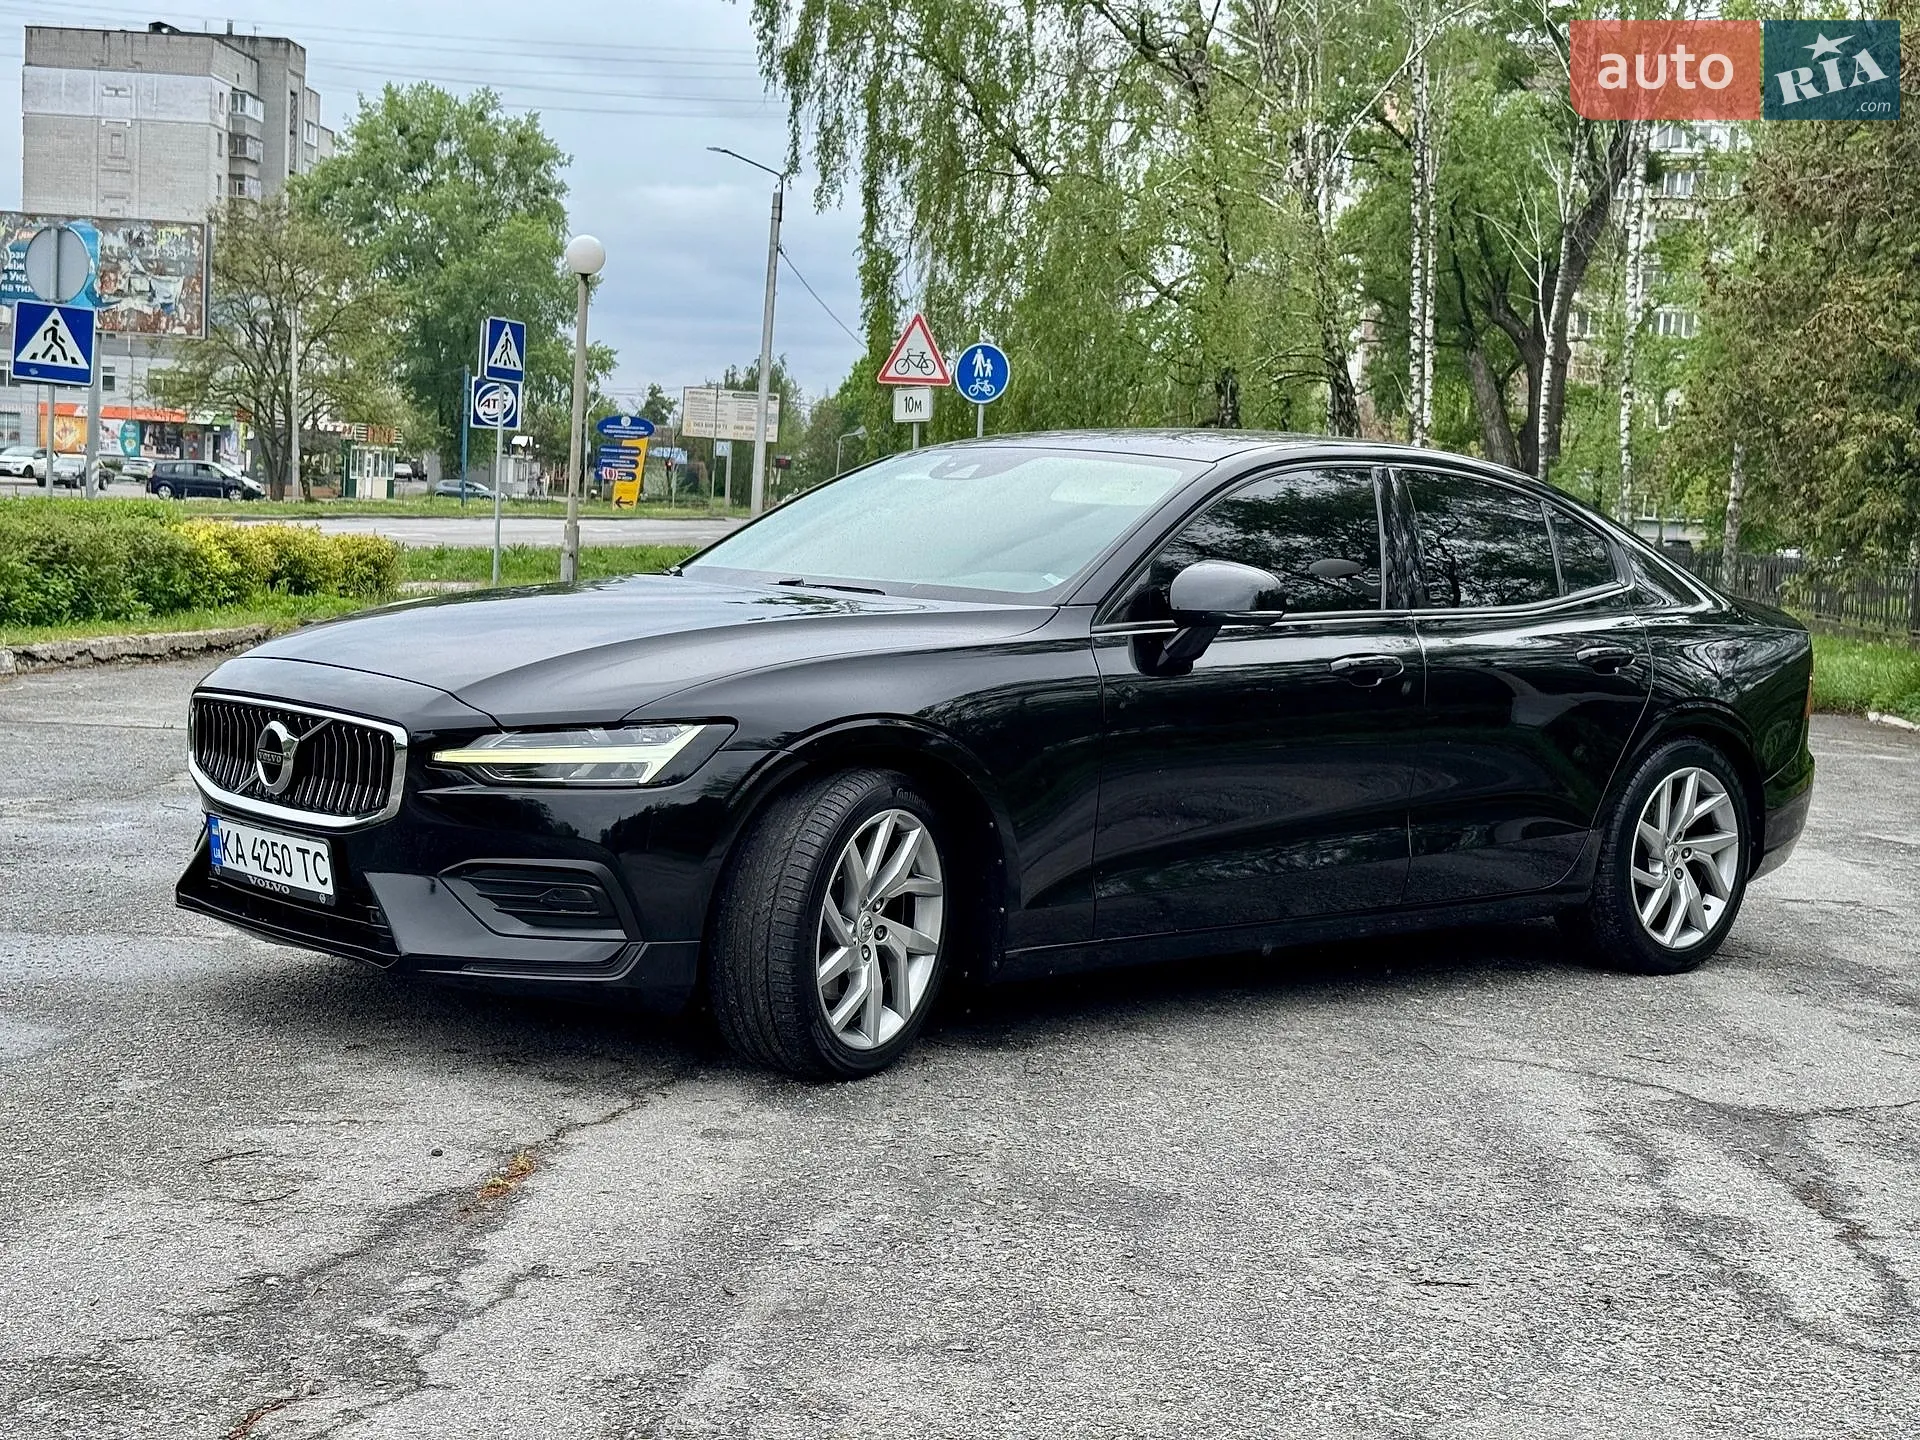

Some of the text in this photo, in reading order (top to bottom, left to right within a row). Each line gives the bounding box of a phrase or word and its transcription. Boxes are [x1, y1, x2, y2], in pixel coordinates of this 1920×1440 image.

[220, 828, 328, 886] KA 4250 TC
[247, 874, 290, 895] VOLVO
